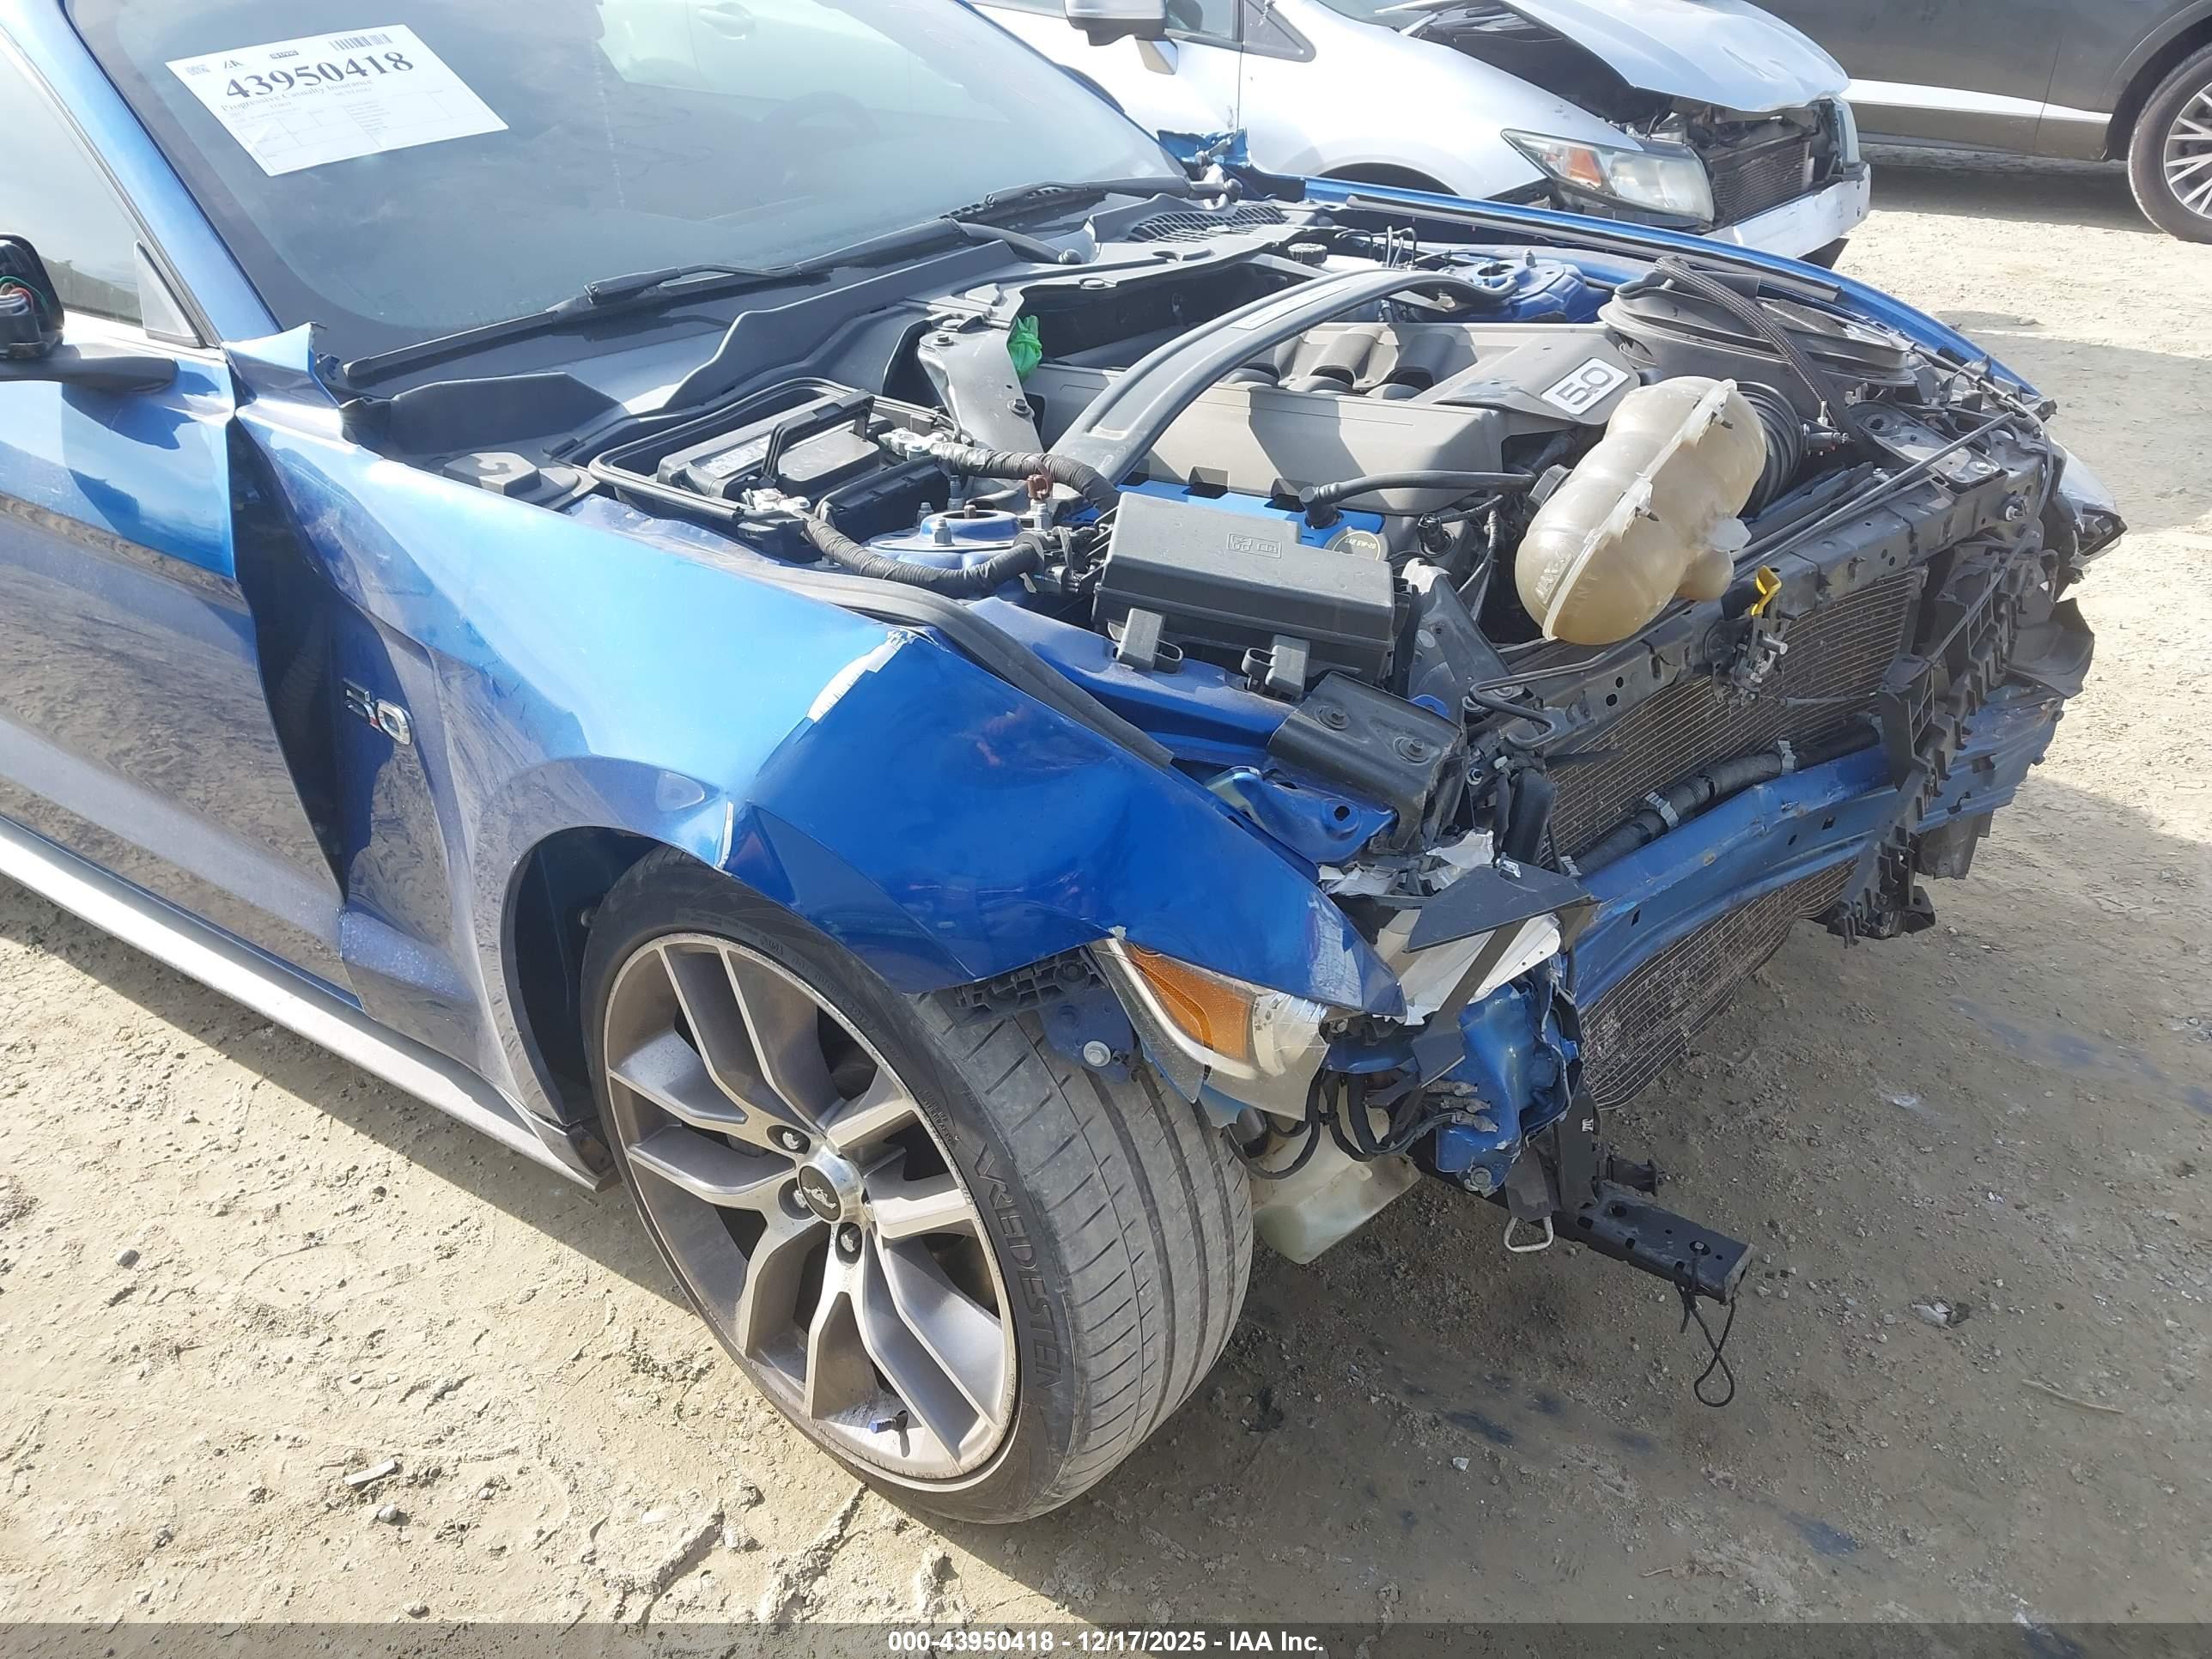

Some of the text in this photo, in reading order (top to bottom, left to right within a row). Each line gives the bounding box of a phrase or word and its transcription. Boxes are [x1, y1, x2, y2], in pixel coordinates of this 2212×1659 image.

[221, 79, 373, 112] Progressive Casualty Insurance
[226, 52, 414, 99] 43950418
[973, 1141, 1065, 1389] VREDESTEIN
